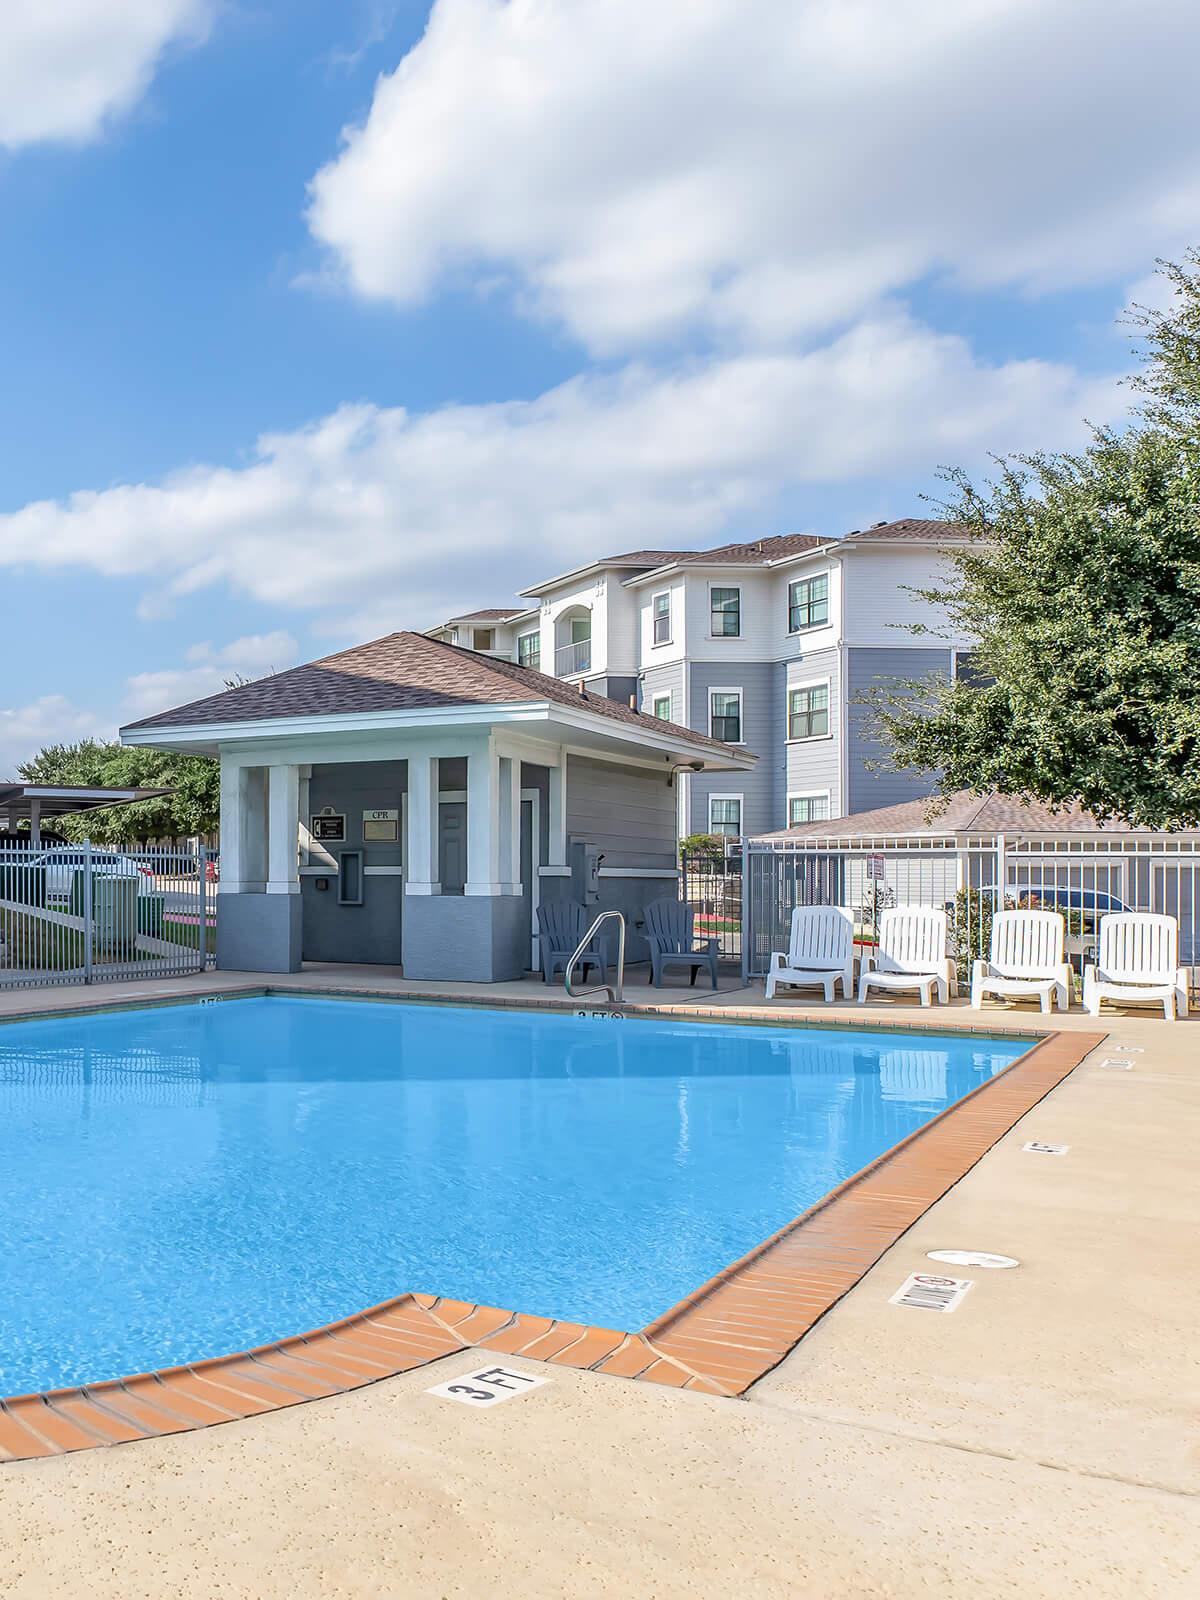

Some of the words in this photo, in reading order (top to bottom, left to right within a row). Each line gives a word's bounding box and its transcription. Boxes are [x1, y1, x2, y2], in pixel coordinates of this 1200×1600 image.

[372, 811, 389, 819] CPR
[447, 1384, 495, 1401] 3
[472, 1367, 535, 1391] FT
